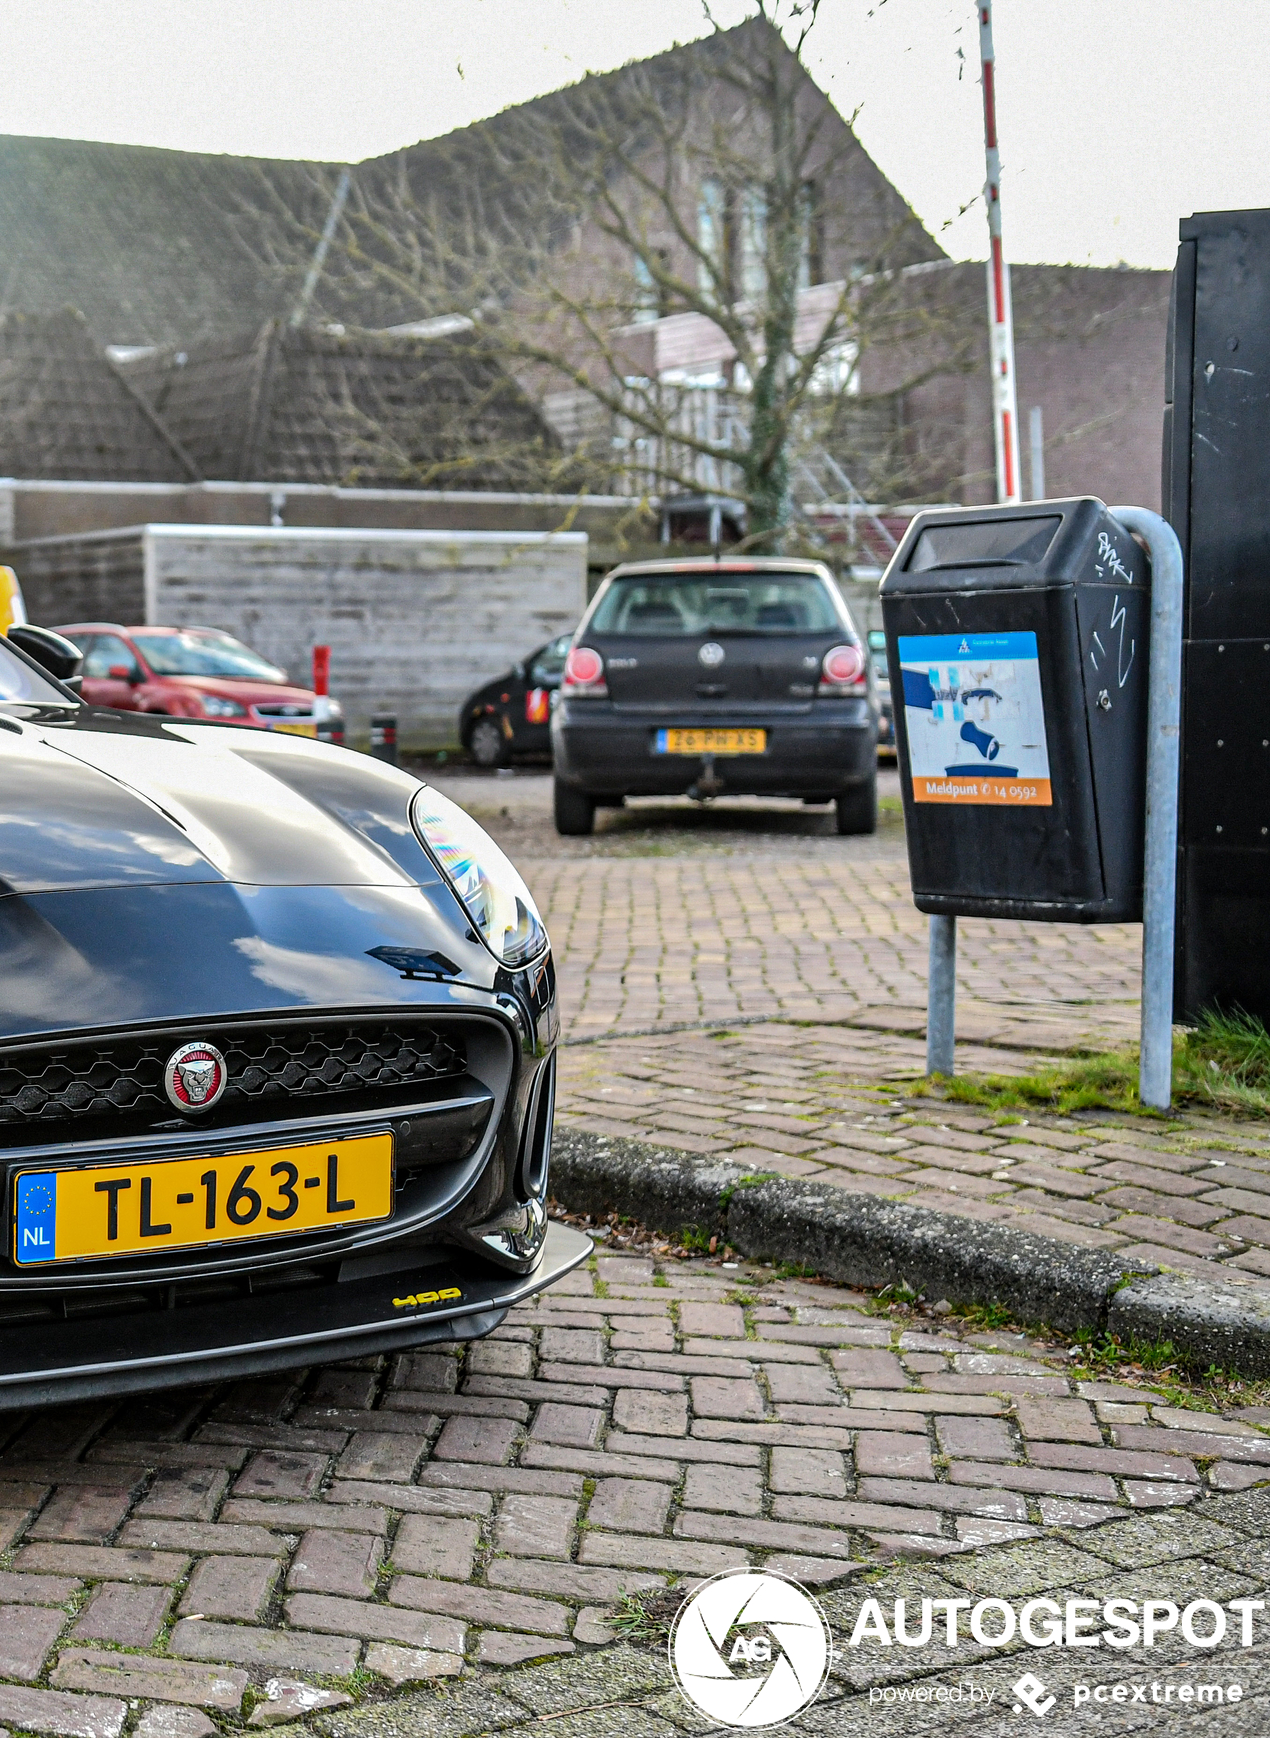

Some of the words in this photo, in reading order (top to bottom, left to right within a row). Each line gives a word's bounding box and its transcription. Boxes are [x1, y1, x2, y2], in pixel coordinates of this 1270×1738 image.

[926, 781, 978, 798] Meldpunt
[994, 785, 1007, 798] 14
[1009, 786, 1037, 800] 0592
[168, 1043, 223, 1071] JAGUAR
[94, 1154, 356, 1241] TL-163-L
[23, 1226, 50, 1247] NL
[391, 1287, 462, 1307] 400
